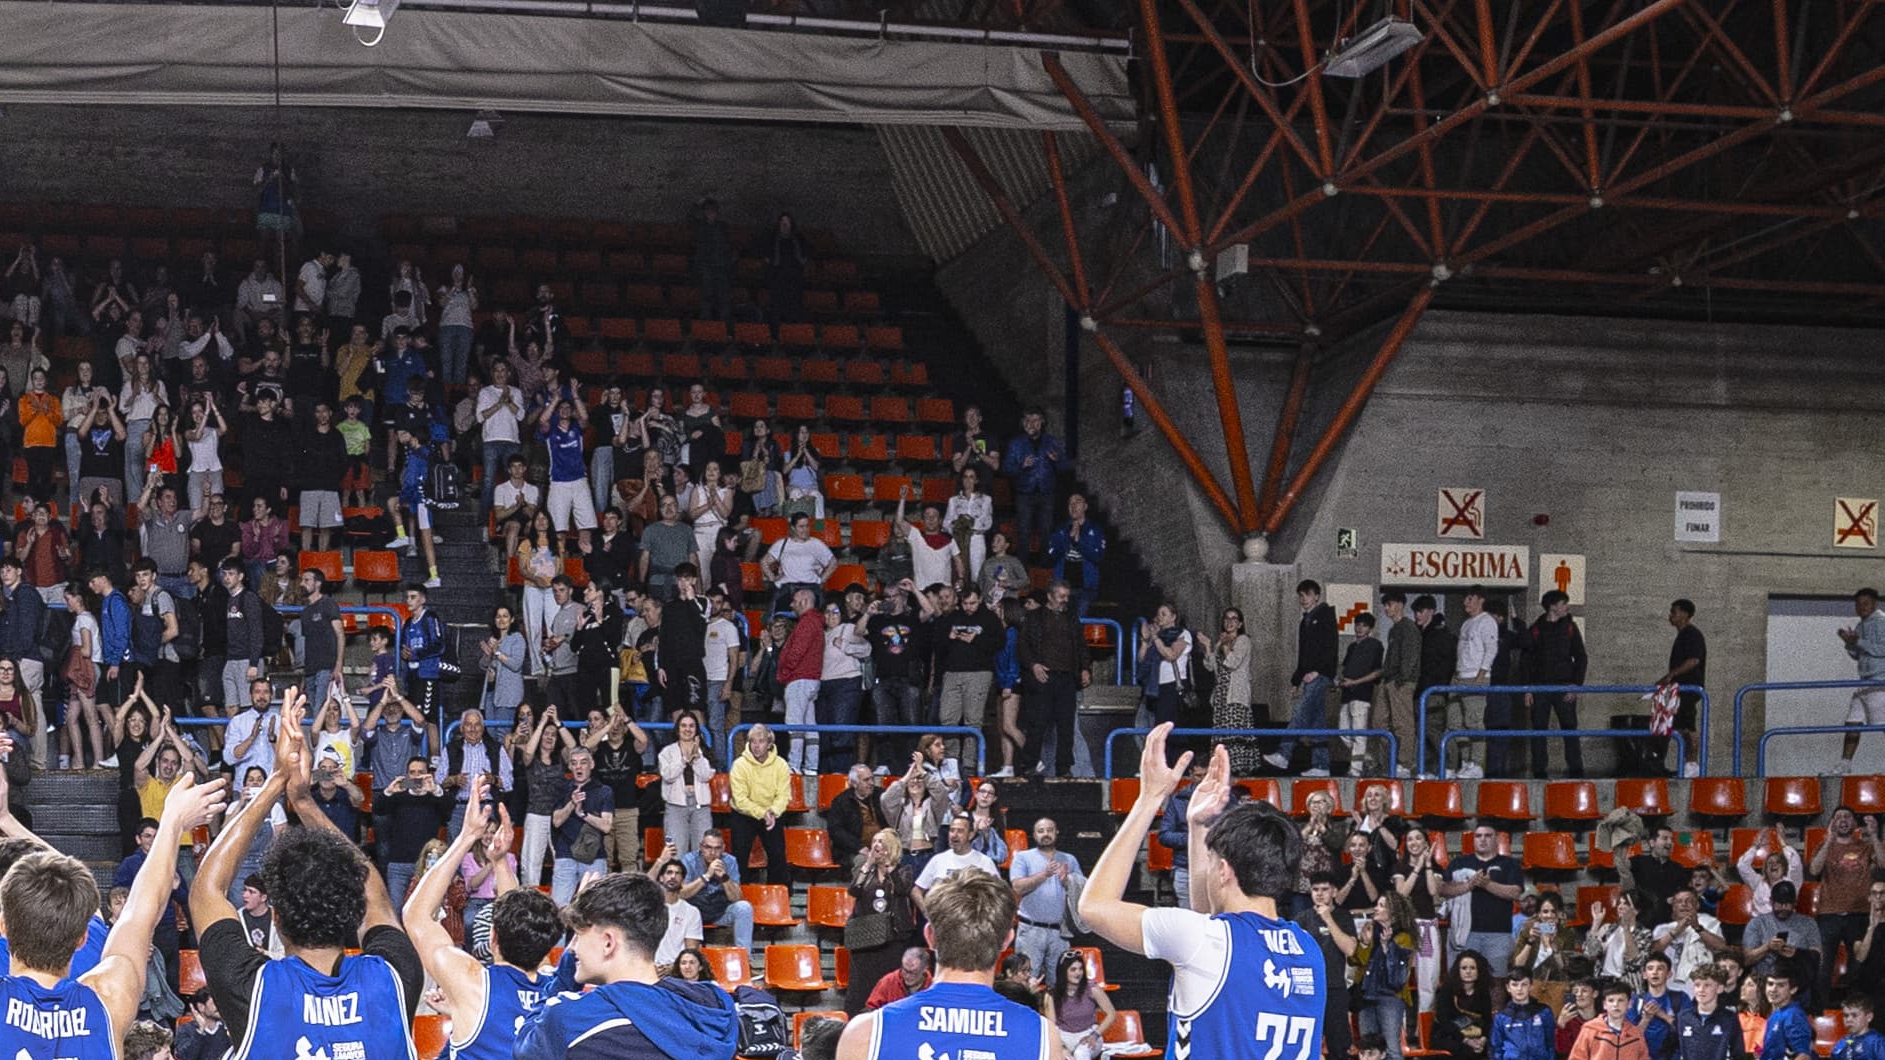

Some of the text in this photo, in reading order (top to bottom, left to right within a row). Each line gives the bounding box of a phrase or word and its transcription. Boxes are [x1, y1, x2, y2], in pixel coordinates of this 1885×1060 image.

[1680, 500, 1715, 511] PROHIBIDO
[1686, 522, 1710, 533] FUMAR
[1409, 550, 1524, 580] ESGRIMA
[918, 1006, 1008, 1037] SAMUEL
